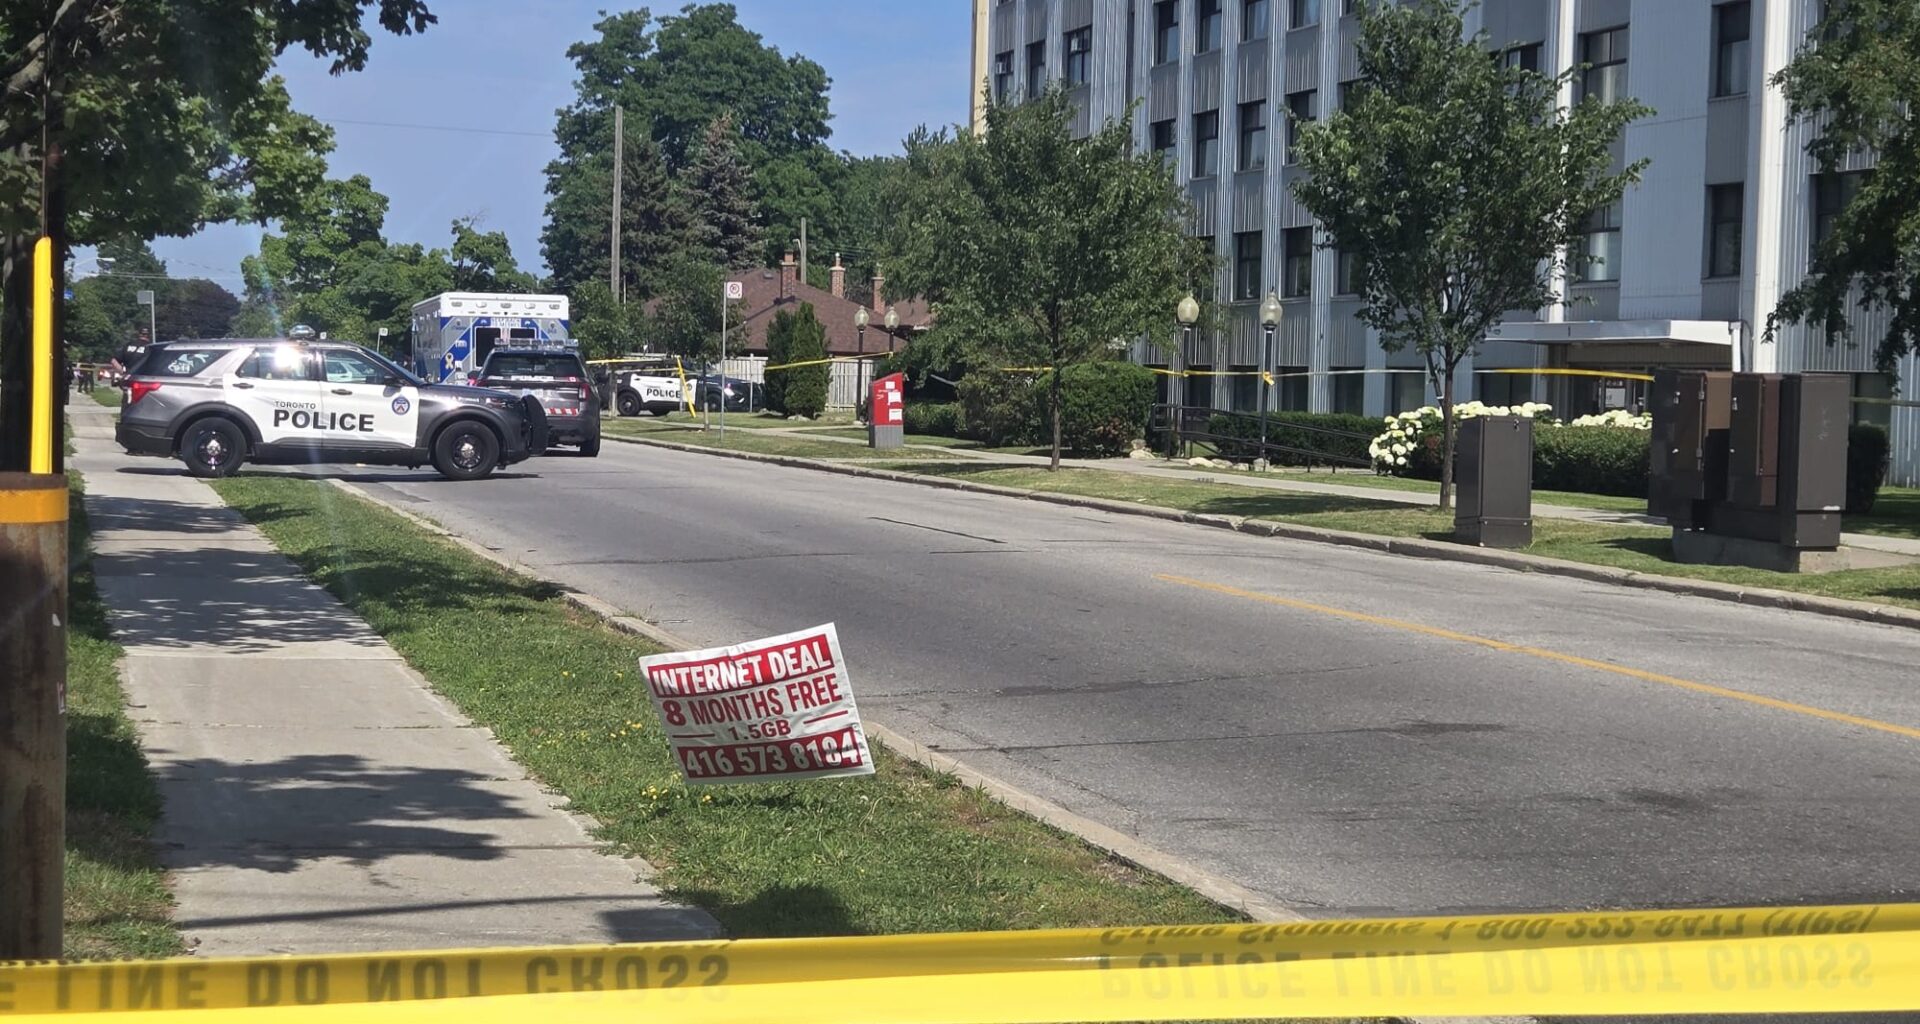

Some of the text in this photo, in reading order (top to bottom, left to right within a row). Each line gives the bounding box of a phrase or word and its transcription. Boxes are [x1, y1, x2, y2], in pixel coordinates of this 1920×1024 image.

[646, 388, 680, 398] POLICE
[274, 401, 316, 410] TORONTO
[273, 409, 375, 432] POLICE
[652, 641, 832, 696] INTERNET DEAL
[662, 673, 843, 726] 8 MONTHS FREE
[728, 719, 791, 742] 1.5GB
[685, 730, 860, 776] 416 573 8184
